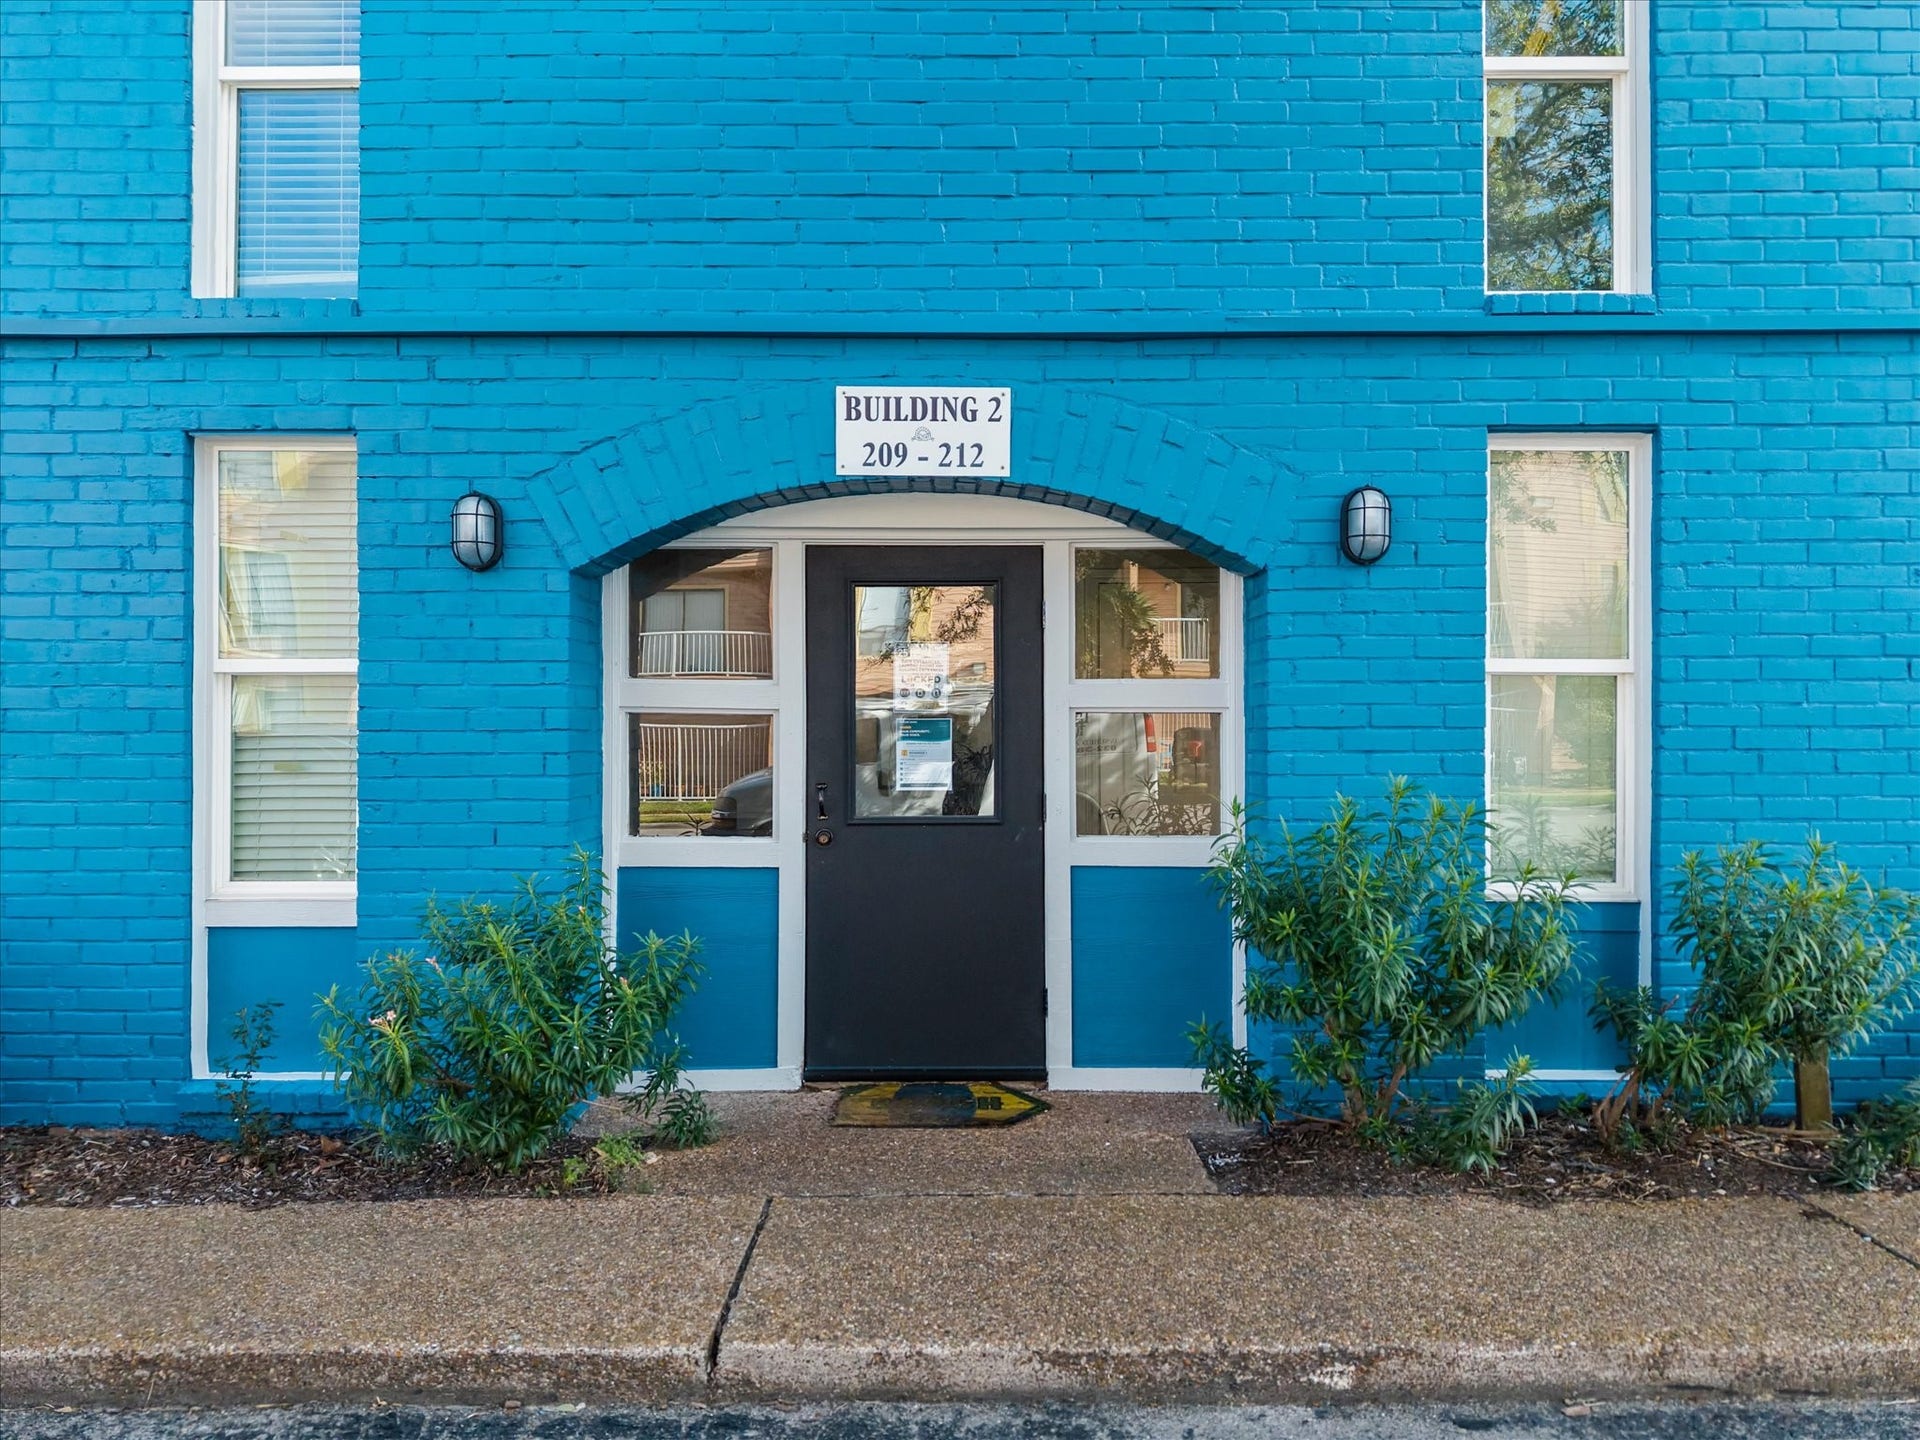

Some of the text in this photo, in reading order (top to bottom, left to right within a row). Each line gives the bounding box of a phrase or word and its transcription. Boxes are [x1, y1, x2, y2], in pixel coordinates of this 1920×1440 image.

[844, 396, 1002, 422] BUILDING 2
[862, 442, 908, 468] 209
[938, 442, 984, 468] 212
